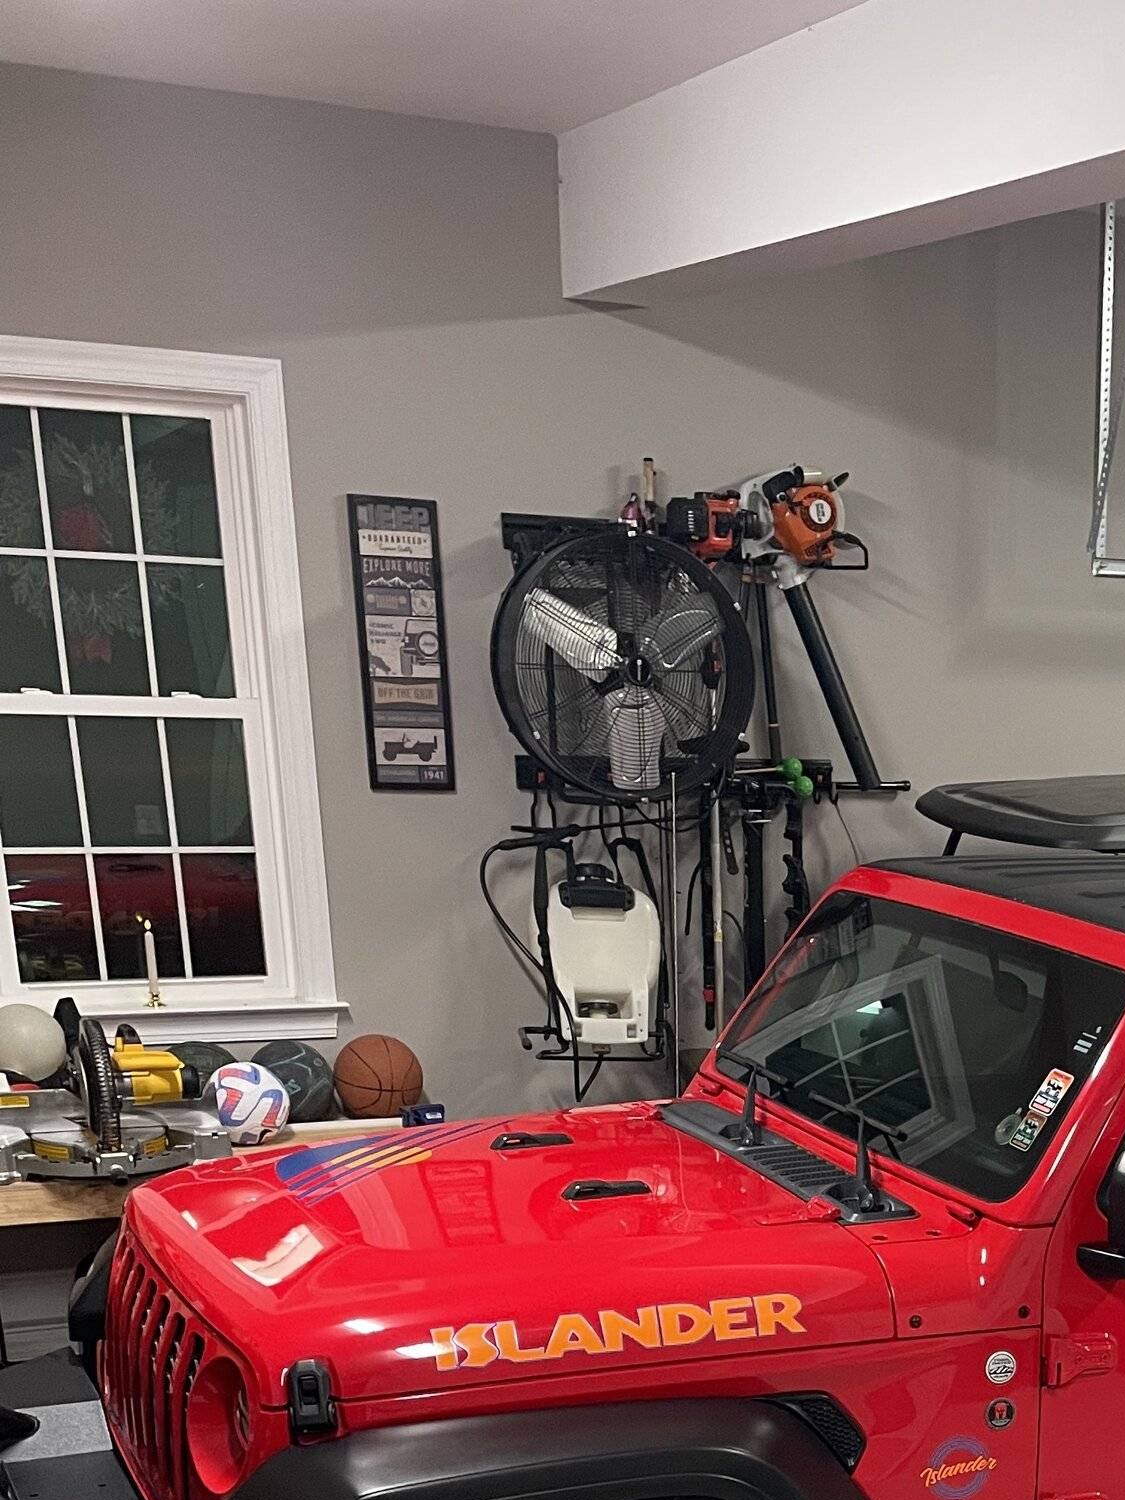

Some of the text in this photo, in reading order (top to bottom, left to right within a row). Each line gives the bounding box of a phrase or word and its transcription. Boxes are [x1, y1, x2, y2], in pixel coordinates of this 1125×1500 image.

[363, 558, 431, 577] EXPLORE MORE
[424, 770, 445, 780] 1941
[430, 1293, 807, 1371] ISLANDER
[920, 1455, 997, 1487] Islander
